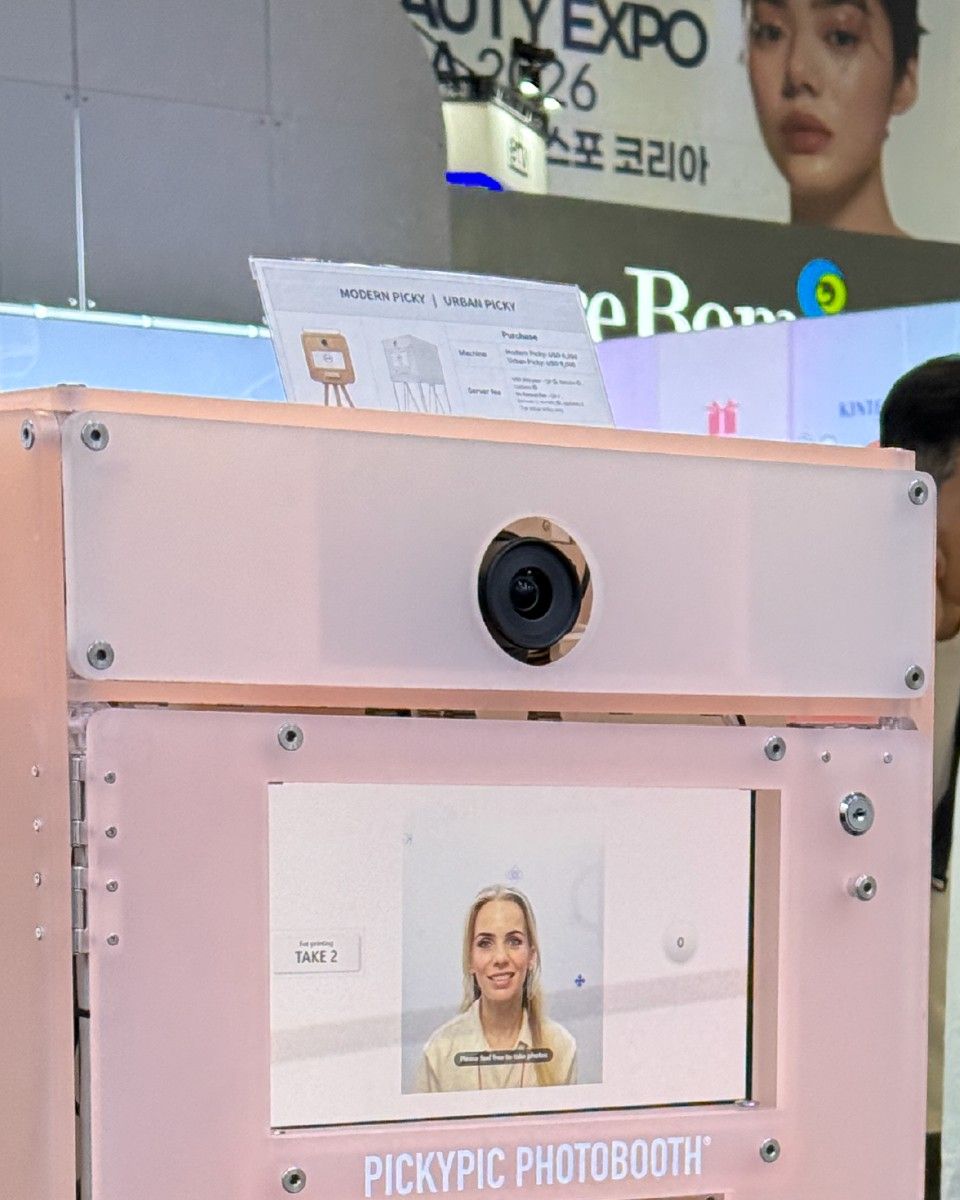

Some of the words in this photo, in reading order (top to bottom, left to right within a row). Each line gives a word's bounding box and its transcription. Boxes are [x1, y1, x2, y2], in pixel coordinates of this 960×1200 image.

[563, 0, 709, 69] EXPO
[614, 135, 709, 187] 코리아
[339, 288, 390, 302] MODERN
[392, 293, 425, 304] PICKY
[443, 296, 483, 309] URBAN
[485, 299, 516, 312] PICKY
[501, 331, 538, 341] Purchase
[294, 950, 327, 964] TAKE
[330, 949, 338, 963] 2
[364, 1147, 505, 1198] PICKYPIC
